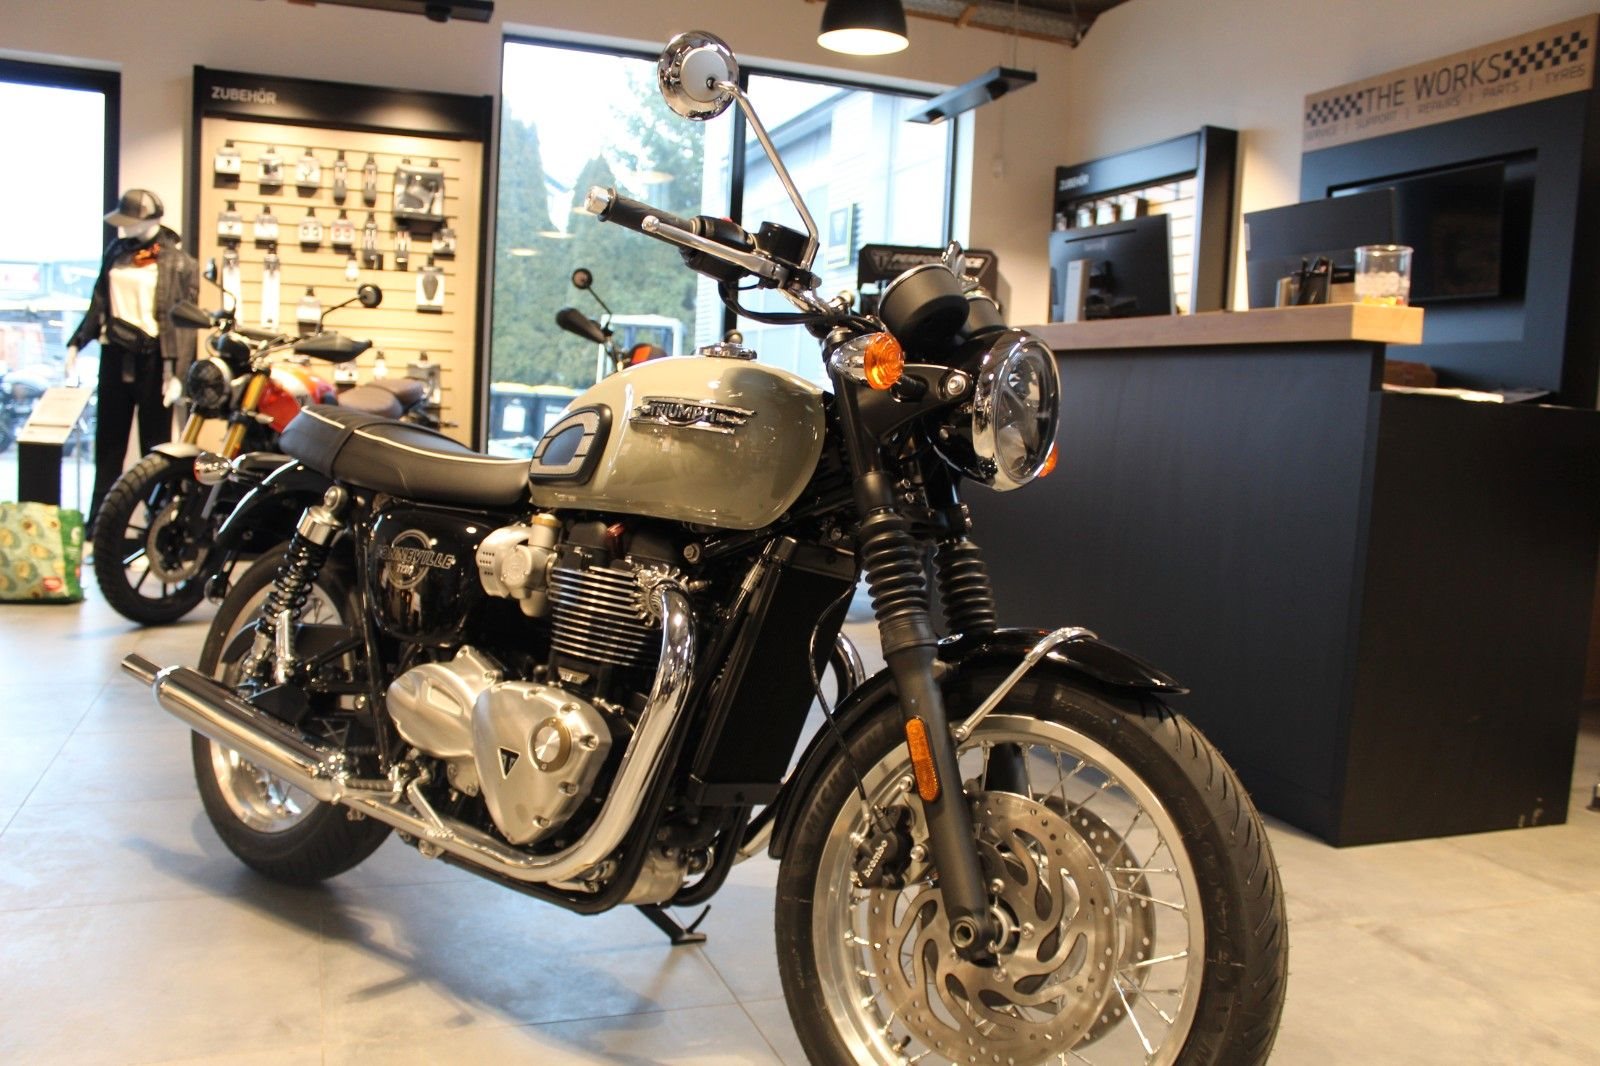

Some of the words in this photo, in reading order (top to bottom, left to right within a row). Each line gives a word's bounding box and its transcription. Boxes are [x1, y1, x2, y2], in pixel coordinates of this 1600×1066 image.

[1365, 79, 1405, 112] THE
[1414, 53, 1502, 98] WORKS
[1482, 81, 1519, 98] PARTS
[1544, 64, 1586, 84] TYRES
[211, 85, 277, 105] ZUBEHÖR
[649, 402, 717, 422] TRIUMPH
